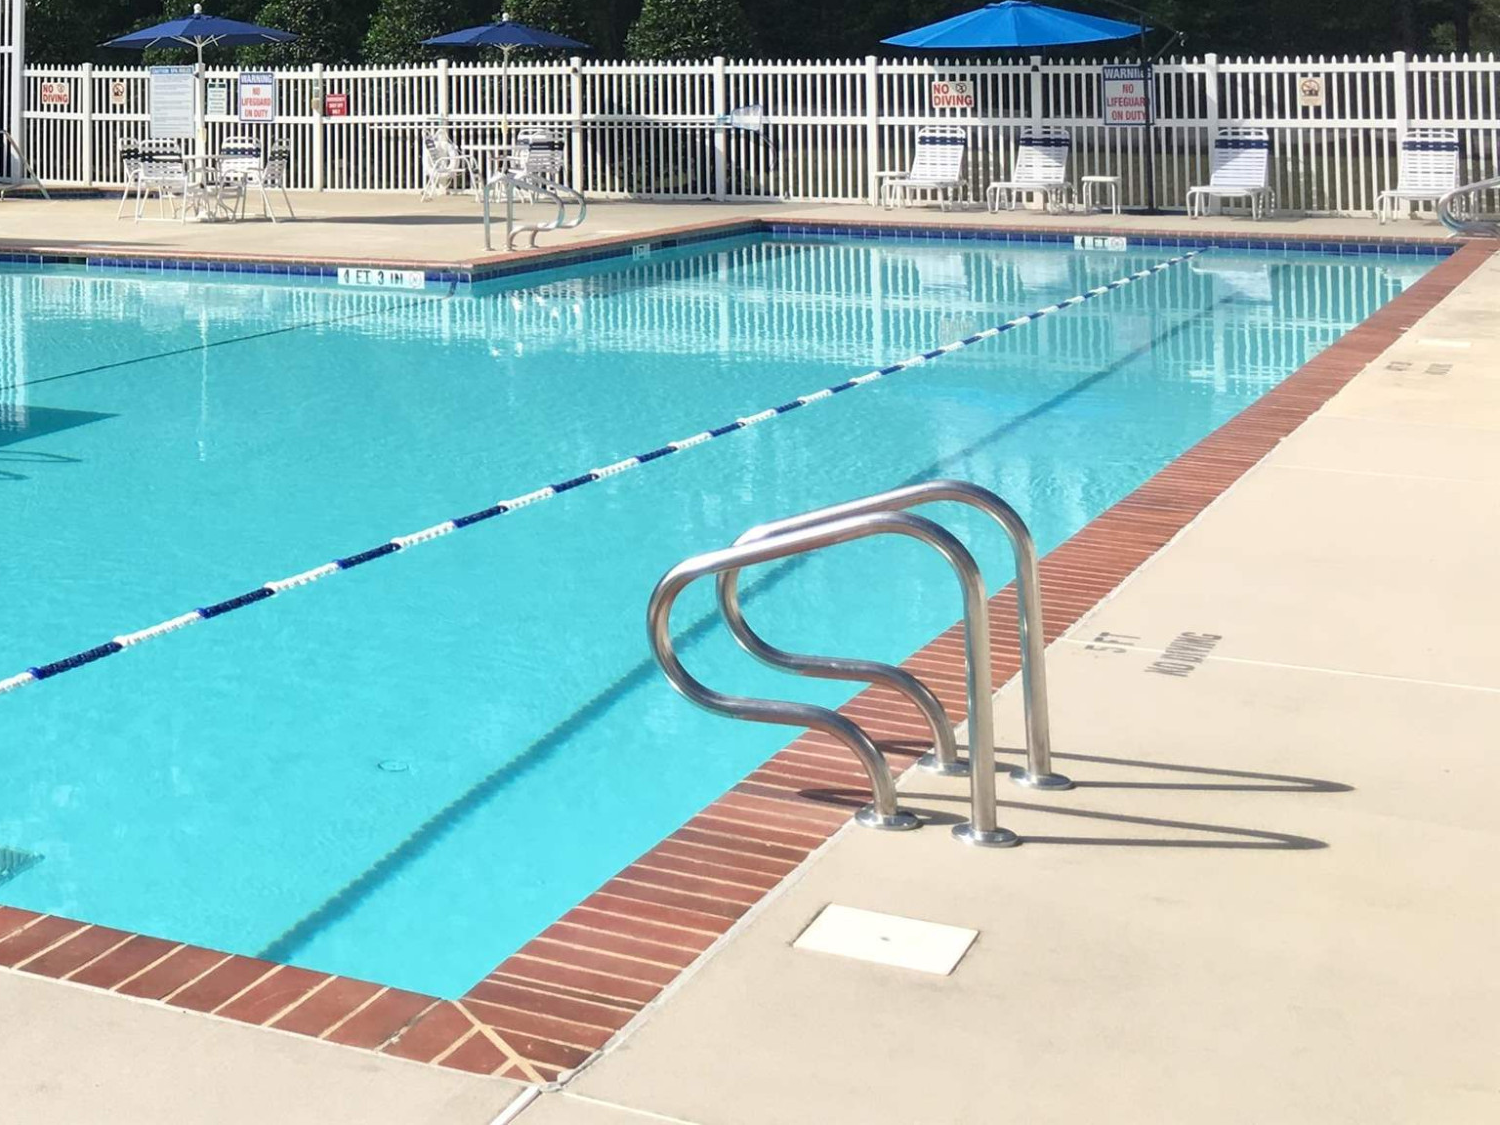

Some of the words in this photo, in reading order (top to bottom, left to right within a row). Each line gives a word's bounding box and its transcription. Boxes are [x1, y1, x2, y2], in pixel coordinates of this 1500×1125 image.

[241, 74, 273, 83] WARNING
[43, 84, 54, 94] NO
[252, 87, 261, 95] NO
[934, 84, 949, 94] NO
[1122, 83, 1134, 94] NO
[43, 94, 68, 103] DIVING
[242, 97, 271, 106] LIFEGUARD
[934, 95, 972, 106] DIVING
[245, 109, 252, 118] ON
[254, 109, 268, 118] DUTY
[1111, 110, 1123, 121] ON
[1159, 631, 1223, 664] DIVING
[1144, 661, 1196, 678] NO
